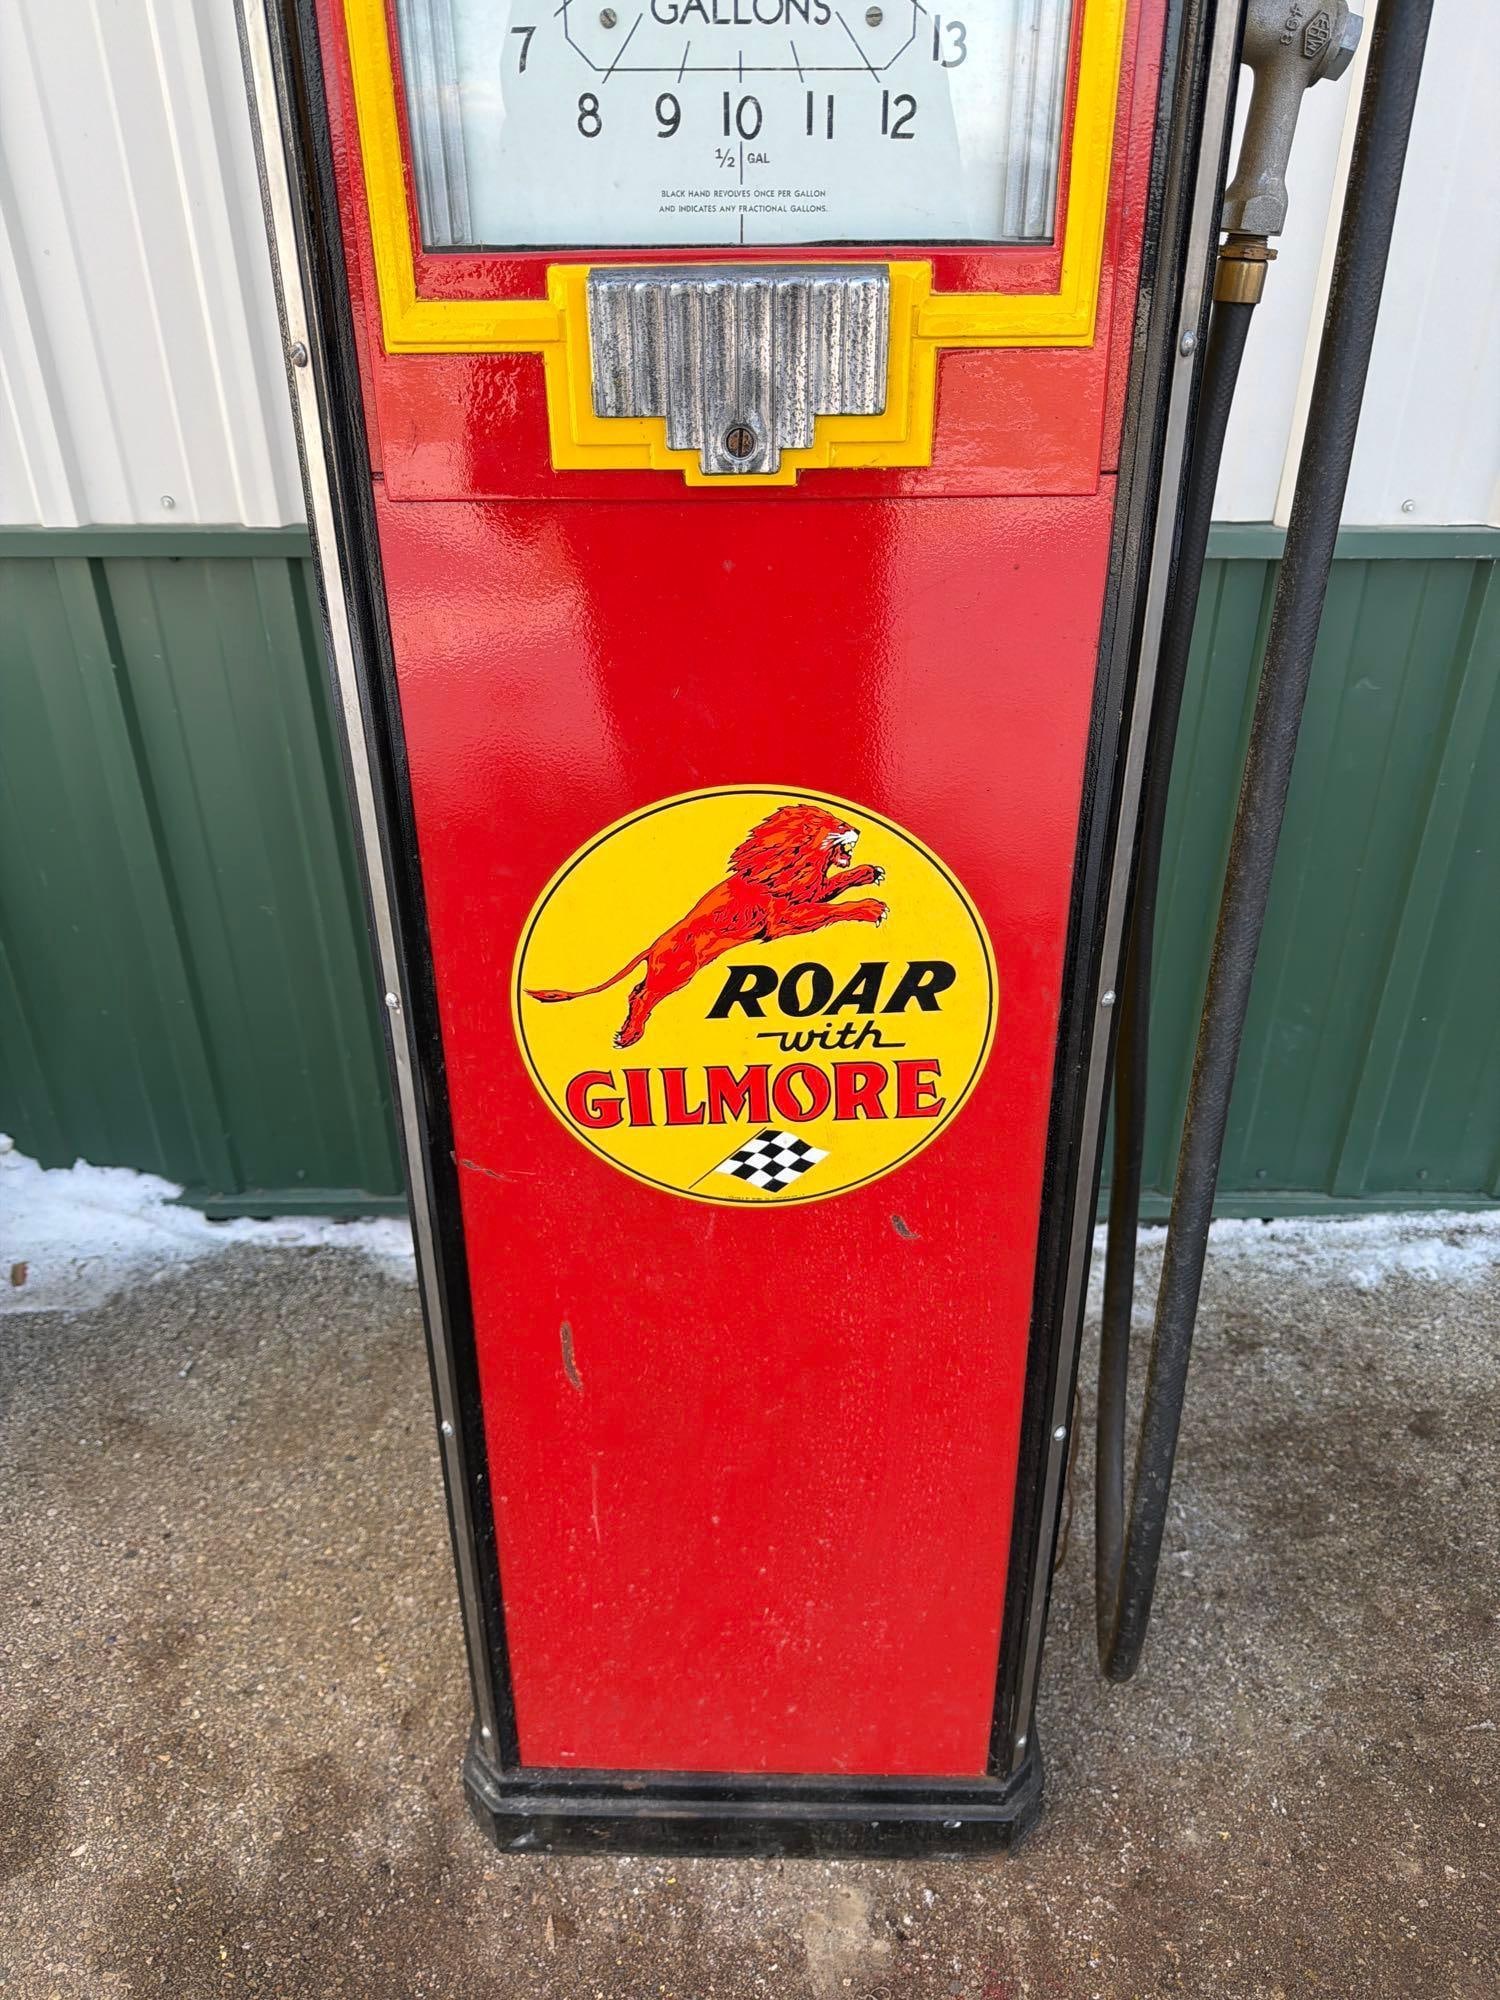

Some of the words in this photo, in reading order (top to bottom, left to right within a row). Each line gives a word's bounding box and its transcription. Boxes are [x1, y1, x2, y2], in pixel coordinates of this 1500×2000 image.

[649, 0, 833, 25] GALLONS
[510, 26, 537, 74] 7
[932, 14, 968, 69] 13
[577, 92, 602, 139] 8
[655, 92, 682, 139] 9
[723, 91, 763, 141] 10
[806, 90, 835, 140] 11
[881, 89, 918, 140] 12
[747, 152, 770, 164] GAL
[659, 204, 676, 213] AND
[678, 204, 717, 213] INDICATES
[719, 204, 736, 213] ANY
[738, 204, 787, 213] FRACTIONAL
[789, 204, 828, 213] GALLONS.
[661, 189, 686, 198] BLACK
[688, 189, 711, 198] HAND
[713, 189, 751, 198] REVOLVES
[753, 189, 775, 198] ONCE
[777, 189, 791, 198] PER
[794, 189, 826, 198] GALLON
[706, 961, 957, 1019] ROAR
[757, 1020, 906, 1052] with
[565, 1059, 947, 1129] GILMORE
